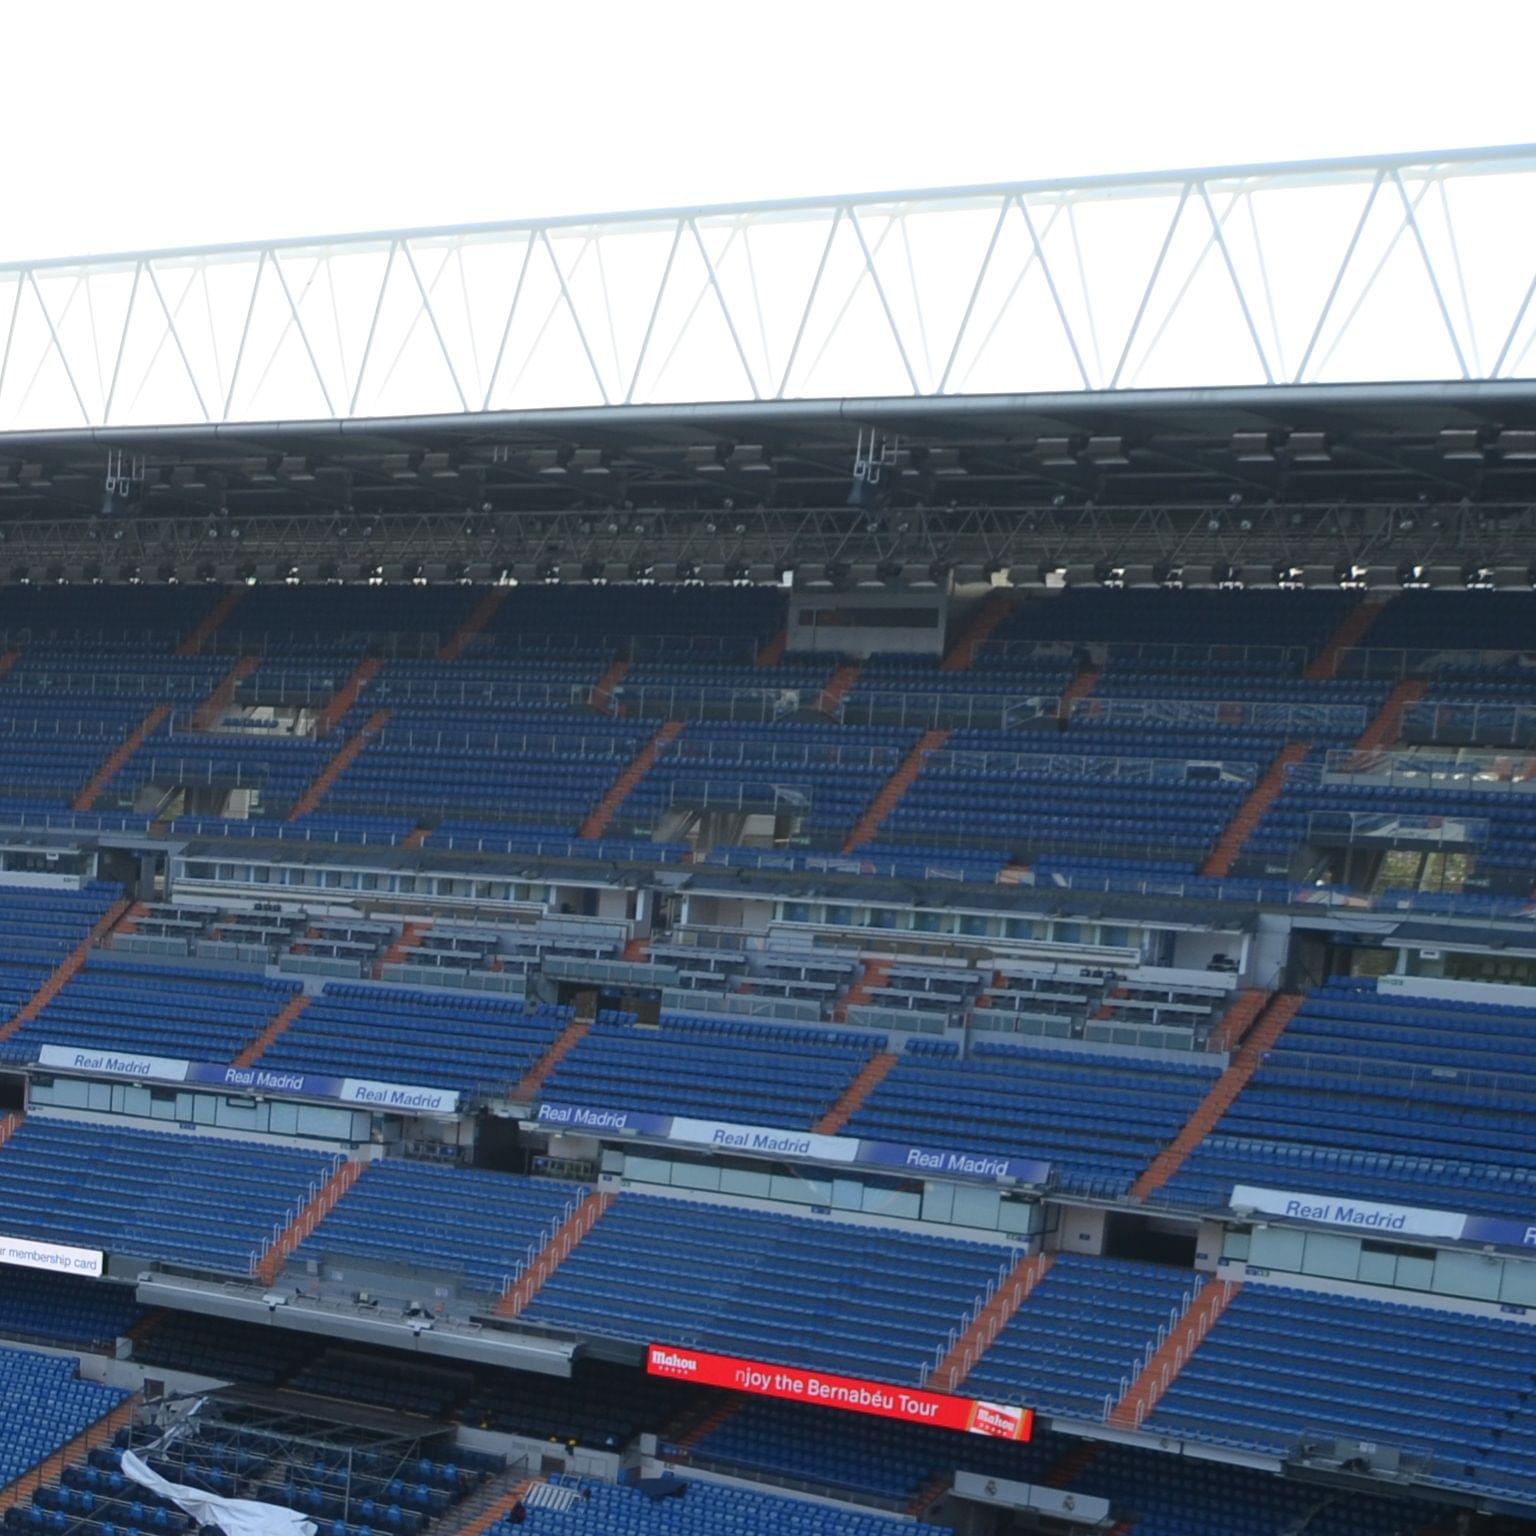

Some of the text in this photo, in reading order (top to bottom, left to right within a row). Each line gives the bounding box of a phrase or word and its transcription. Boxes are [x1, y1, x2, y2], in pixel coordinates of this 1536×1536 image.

[74, 1054, 150, 1074] Real Madrid
[225, 1068, 303, 1089] Real Madrid
[356, 1087, 441, 1108] Real Madrid
[538, 1104, 626, 1128] Real Madrid
[712, 1129, 809, 1154] Real Madrid
[907, 1148, 1009, 1176] Real Madrid
[1286, 1200, 1405, 1229] Real Madrid
[9, 1247, 71, 1268] membership
[74, 1257, 97, 1270] card
[652, 1351, 696, 1371] Mahou
[775, 1372, 803, 1394] the
[808, 1379, 893, 1408] Bernabéu
[898, 1394, 938, 1417] Tour
[977, 1408, 1015, 1431] Mahou
